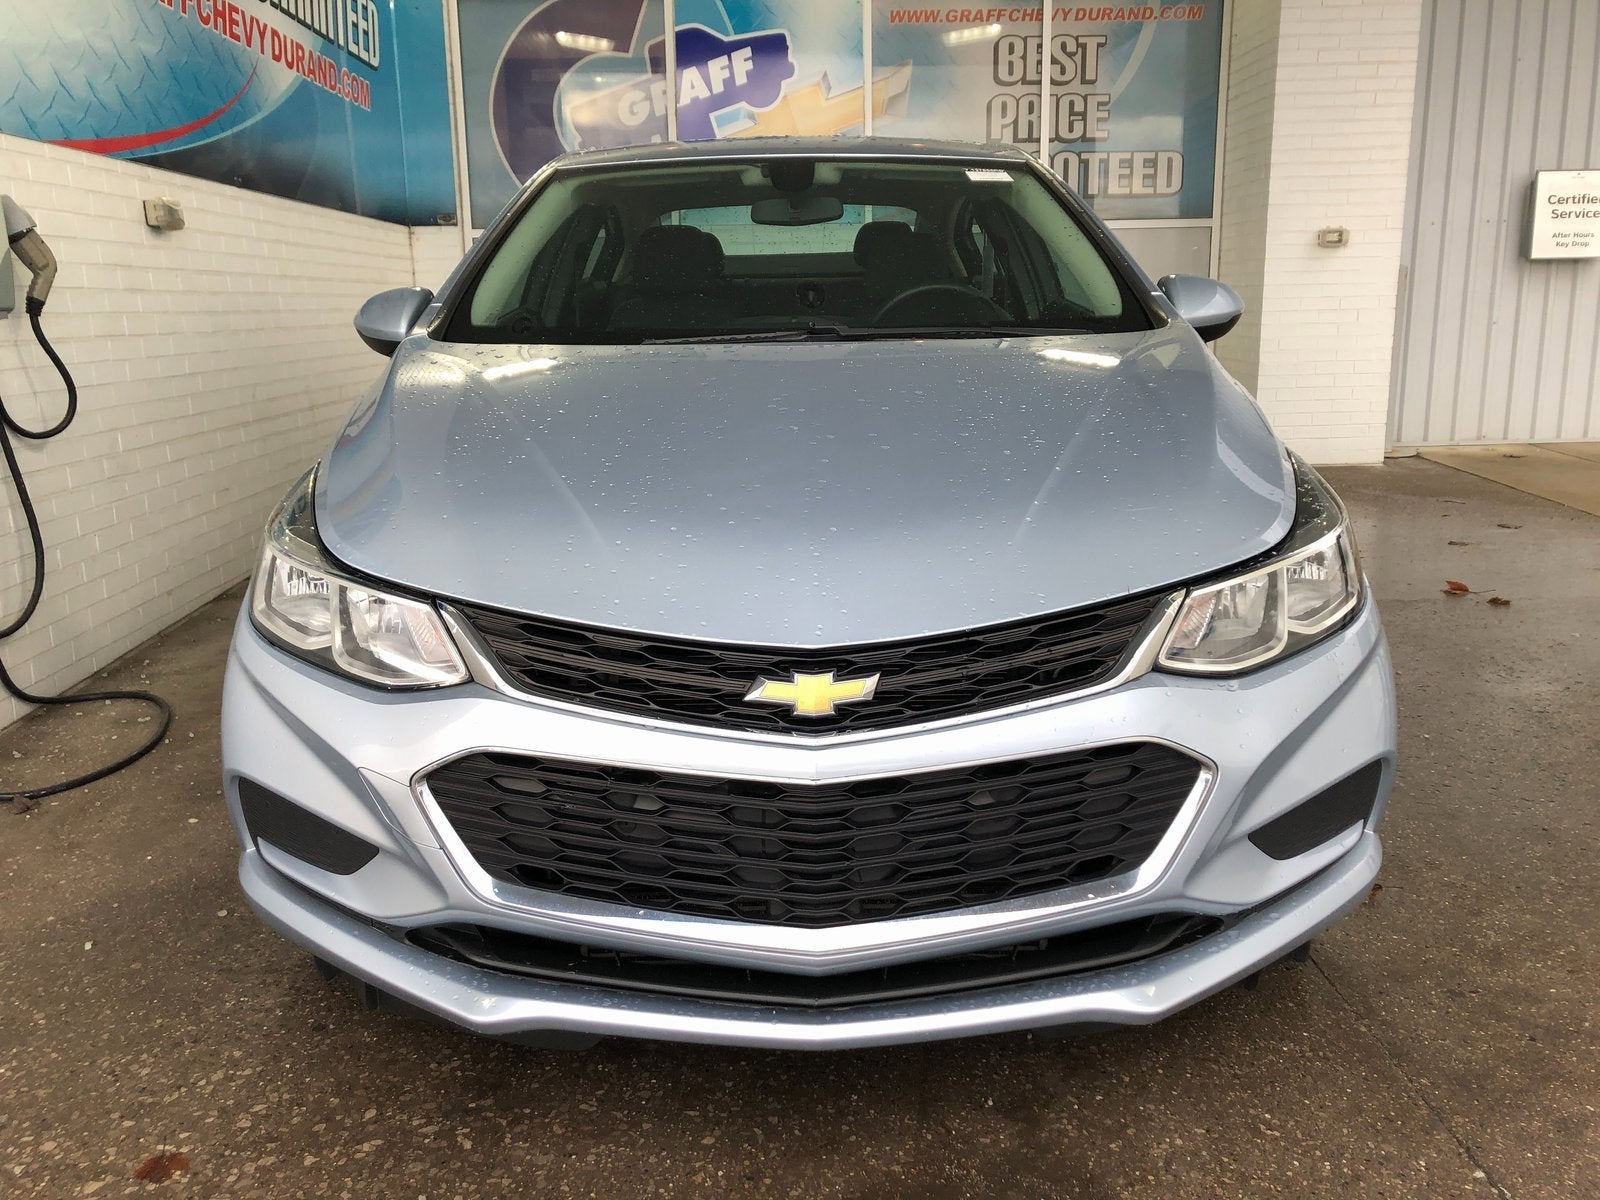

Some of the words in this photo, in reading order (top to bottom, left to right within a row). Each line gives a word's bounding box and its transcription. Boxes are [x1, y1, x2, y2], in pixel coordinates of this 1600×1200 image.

[993, 34, 1107, 86] BEST
[986, 92, 1111, 143] PRICE
[1547, 193, 1600, 205] Certifie
[1551, 208, 1600, 219] Service
[1555, 240, 1570, 248] Key
[1571, 240, 1590, 248] Drop
